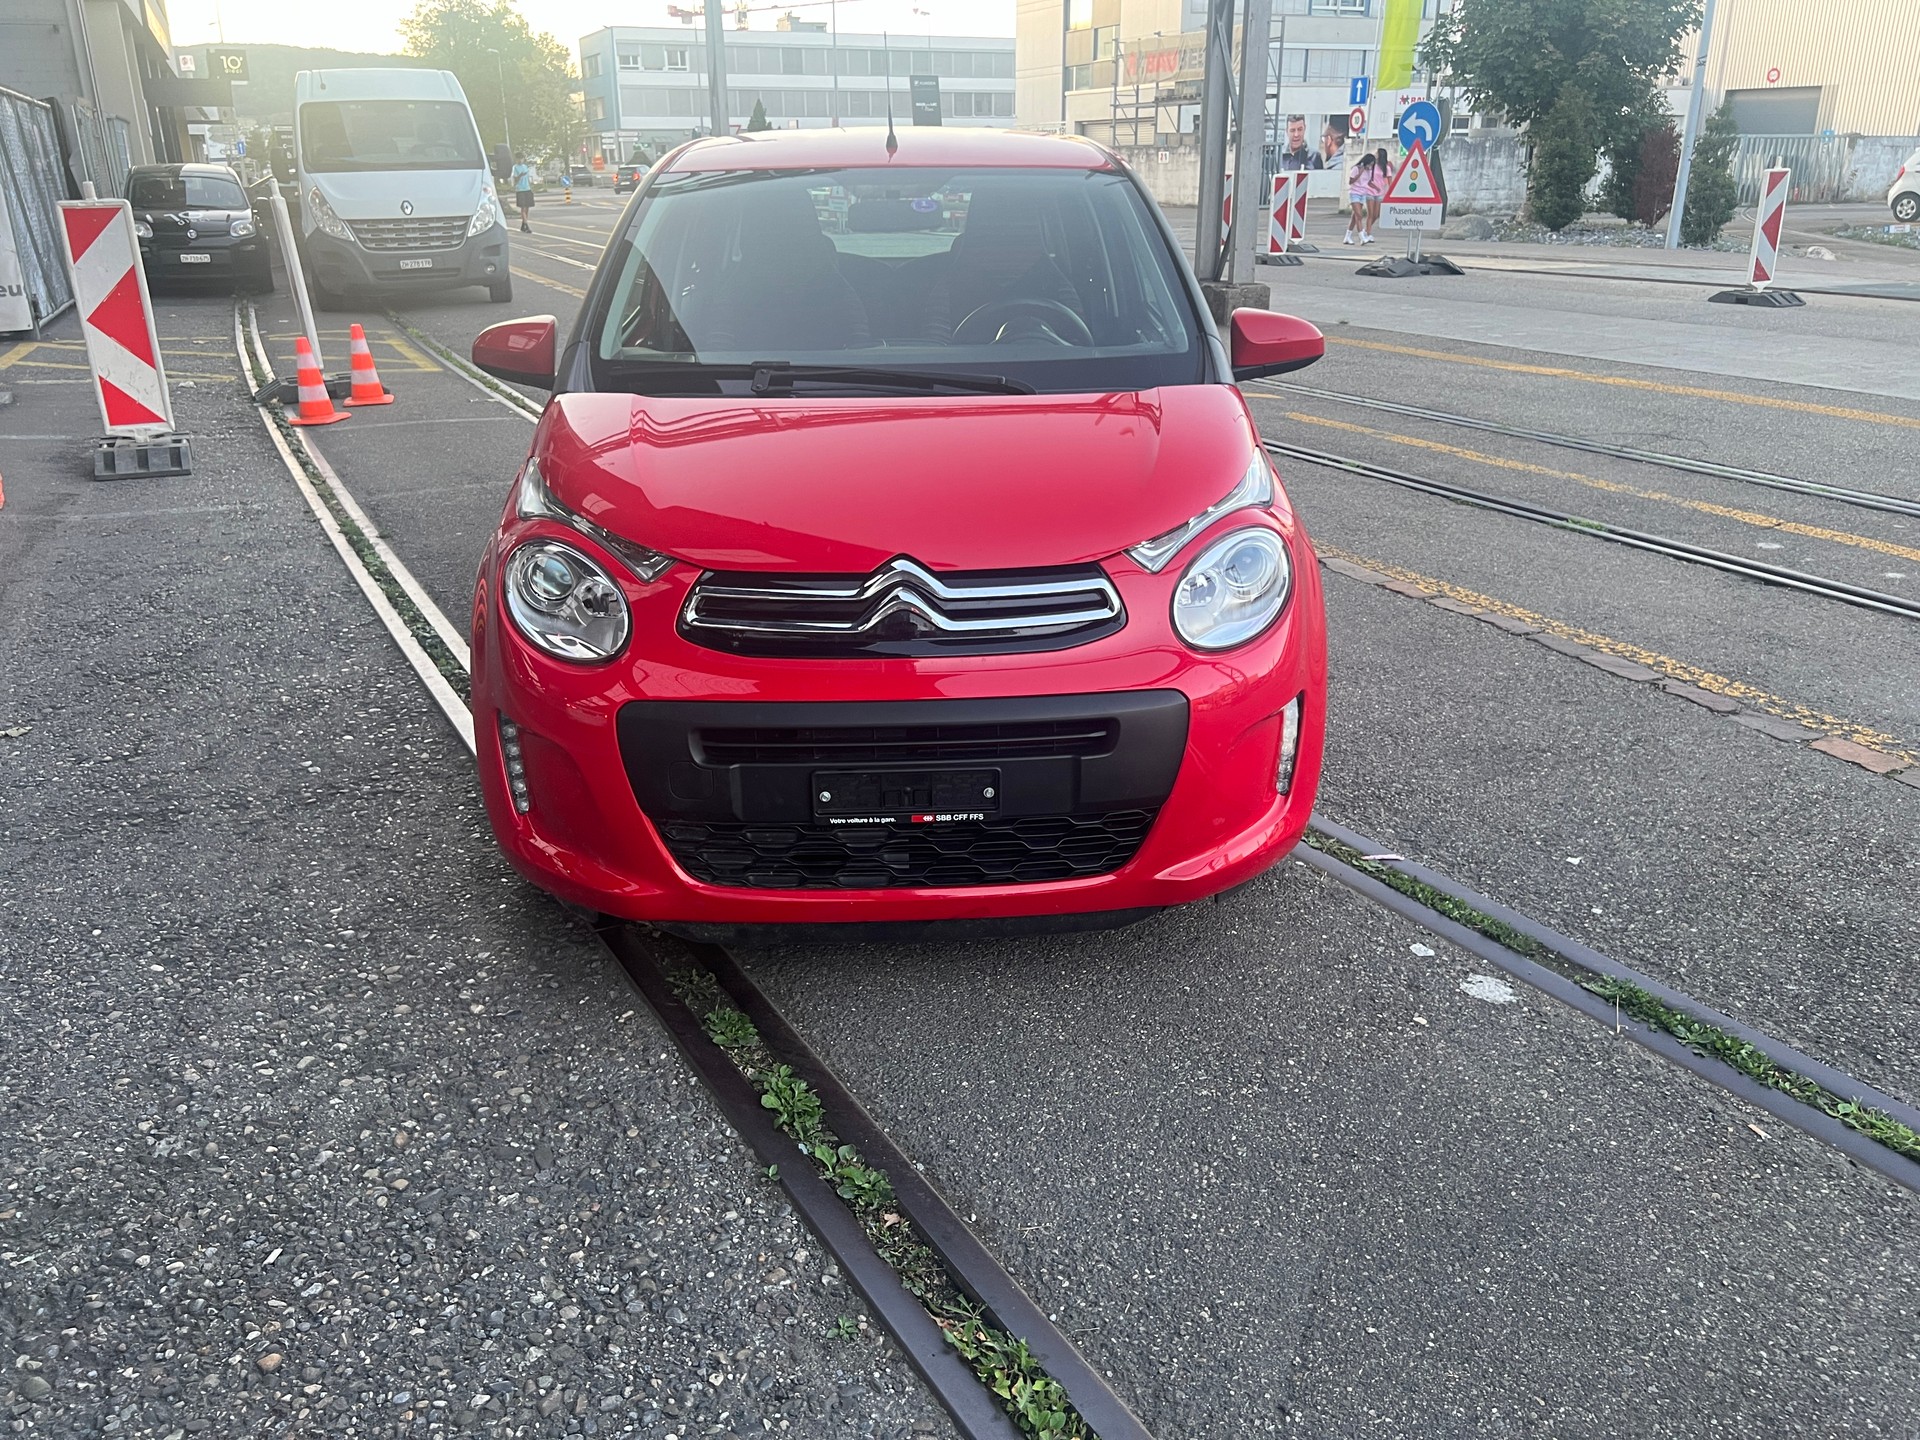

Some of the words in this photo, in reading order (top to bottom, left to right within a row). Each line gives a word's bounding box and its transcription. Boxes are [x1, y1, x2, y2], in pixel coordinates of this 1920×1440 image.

[1389, 206, 1432, 215] Phasenablauf
[1394, 217, 1424, 226] beachten
[935, 814, 952, 822] SBB
[953, 813, 968, 821] CFF
[969, 813, 984, 821] FFS
